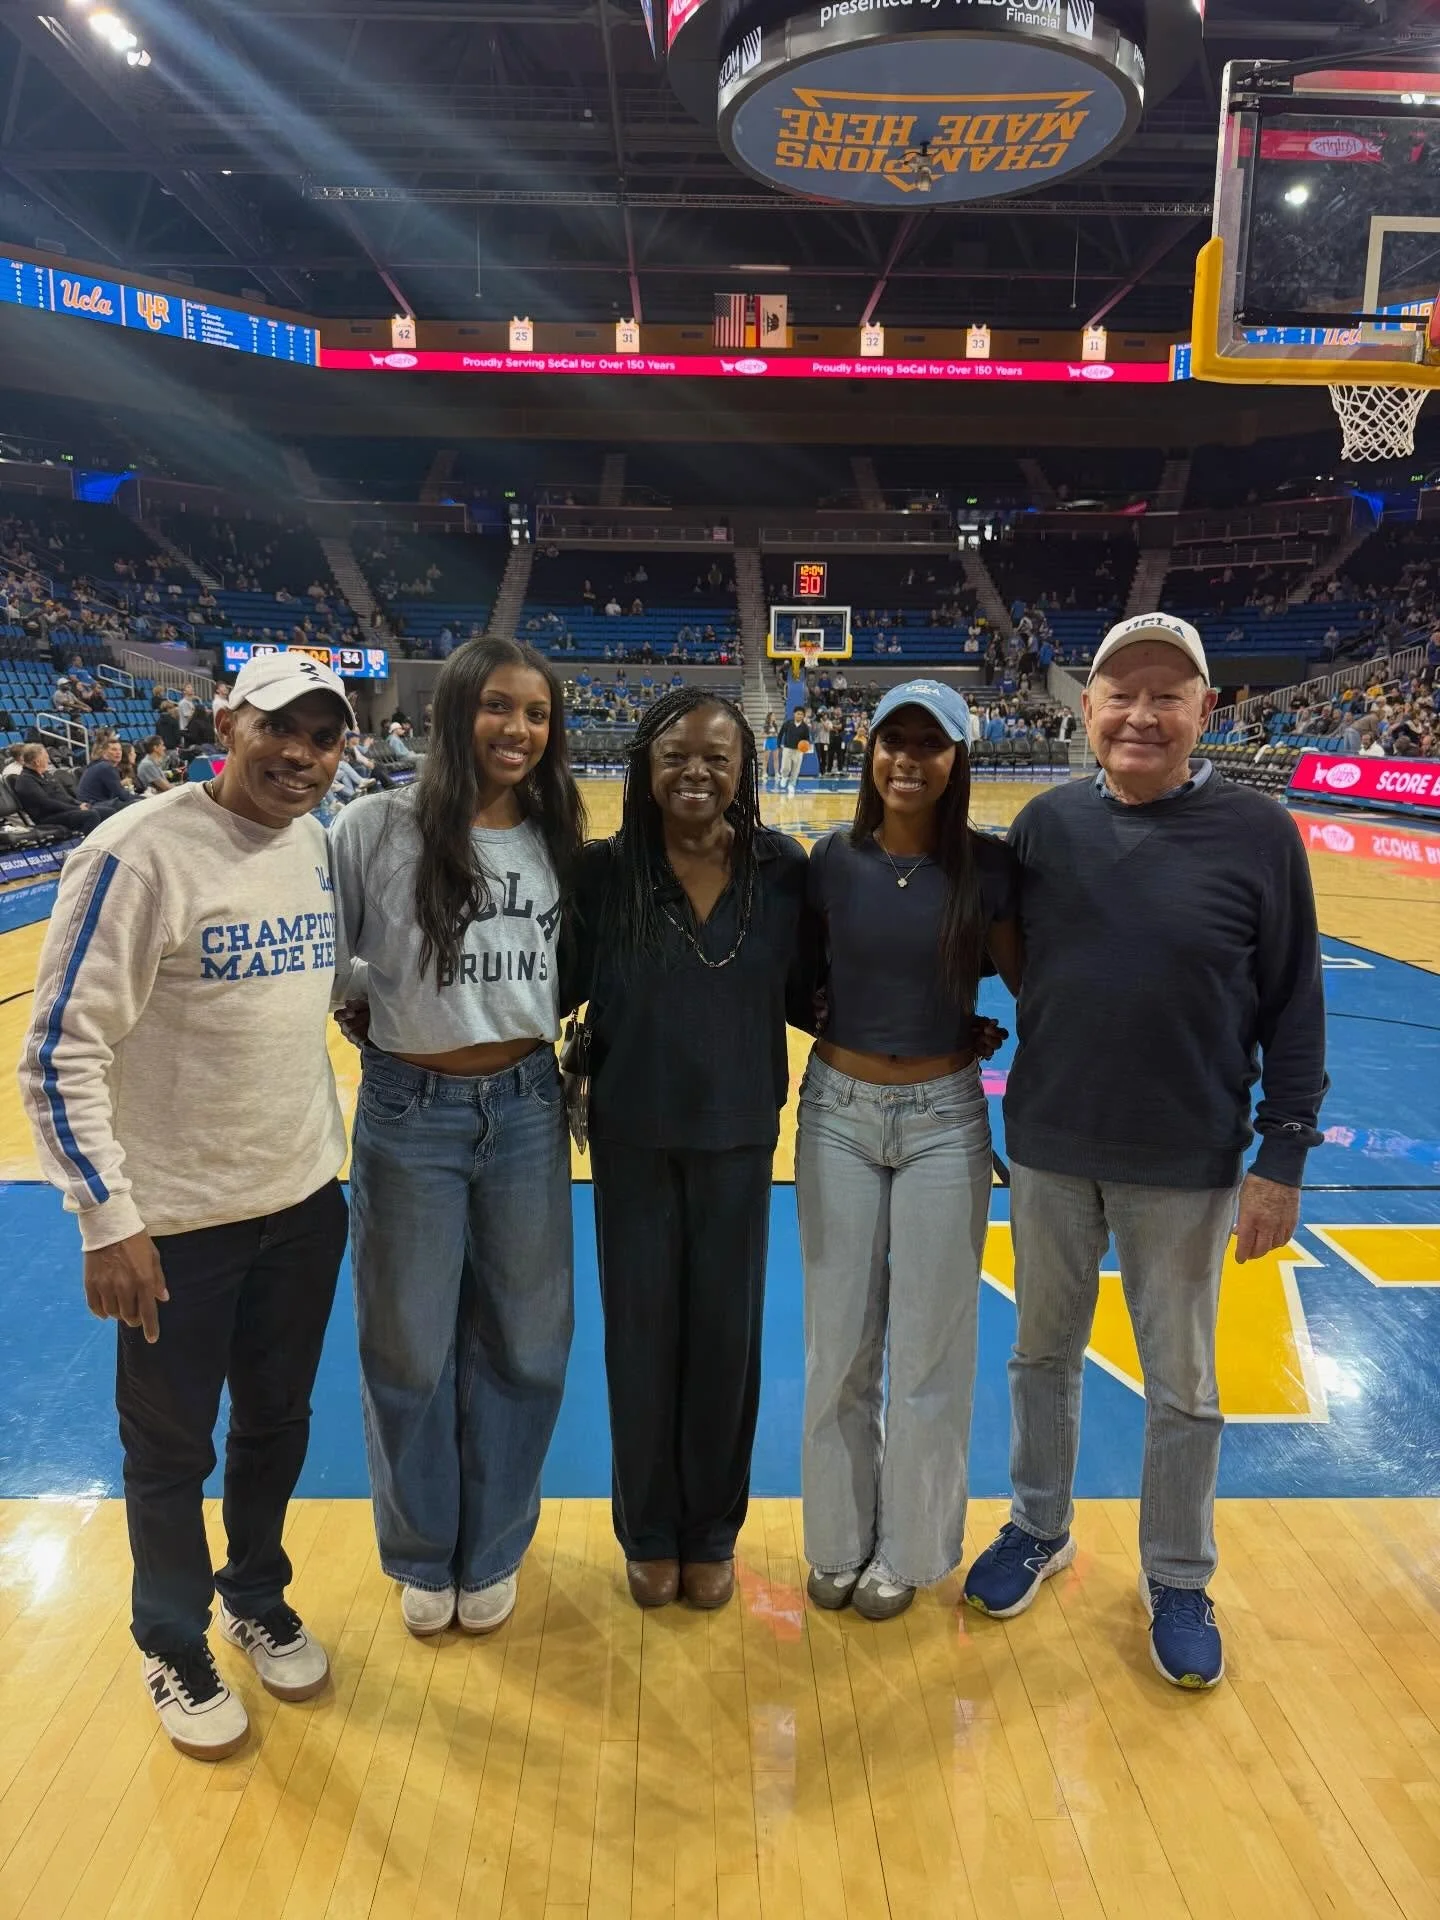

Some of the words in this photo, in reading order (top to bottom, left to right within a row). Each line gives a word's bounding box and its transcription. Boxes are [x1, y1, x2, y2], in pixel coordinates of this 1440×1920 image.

[820, 0, 913, 27] presente
[1006, 8, 1061, 30] Financial
[778, 107, 918, 146] HERE
[931, 110, 1090, 146] MADE
[775, 141, 1070, 174] CHAMPIONS
[60, 279, 114, 316] Ucla
[398, 329, 410, 339] 42
[515, 331, 528, 341] 25
[622, 333, 633, 343] 31
[866, 337, 879, 347] 32
[972, 339, 985, 349] 33
[1089, 340, 1100, 351] 11
[463, 357, 502, 369] Proudly
[505, 358, 544, 370] Serving
[547, 359, 579, 369] SoCal
[581, 359, 596, 369] for
[598, 360, 625, 369] Over
[627, 360, 645, 369] 150
[647, 361, 676, 371] Years
[812, 363, 852, 374] Proudly
[855, 363, 894, 375] Serving
[896, 364, 927, 374] SoCal
[929, 364, 944, 374] for
[947, 365, 972, 375] Over
[974, 365, 992, 375] 150
[995, 365, 1023, 376] Years
[800, 565, 823, 576] 12:04
[800, 576, 820, 594] 30
[342, 651, 360, 665] 34
[1375, 771, 1433, 795] SCORE
[200, 945, 306, 981] MADE
[312, 940, 336, 970] HE
